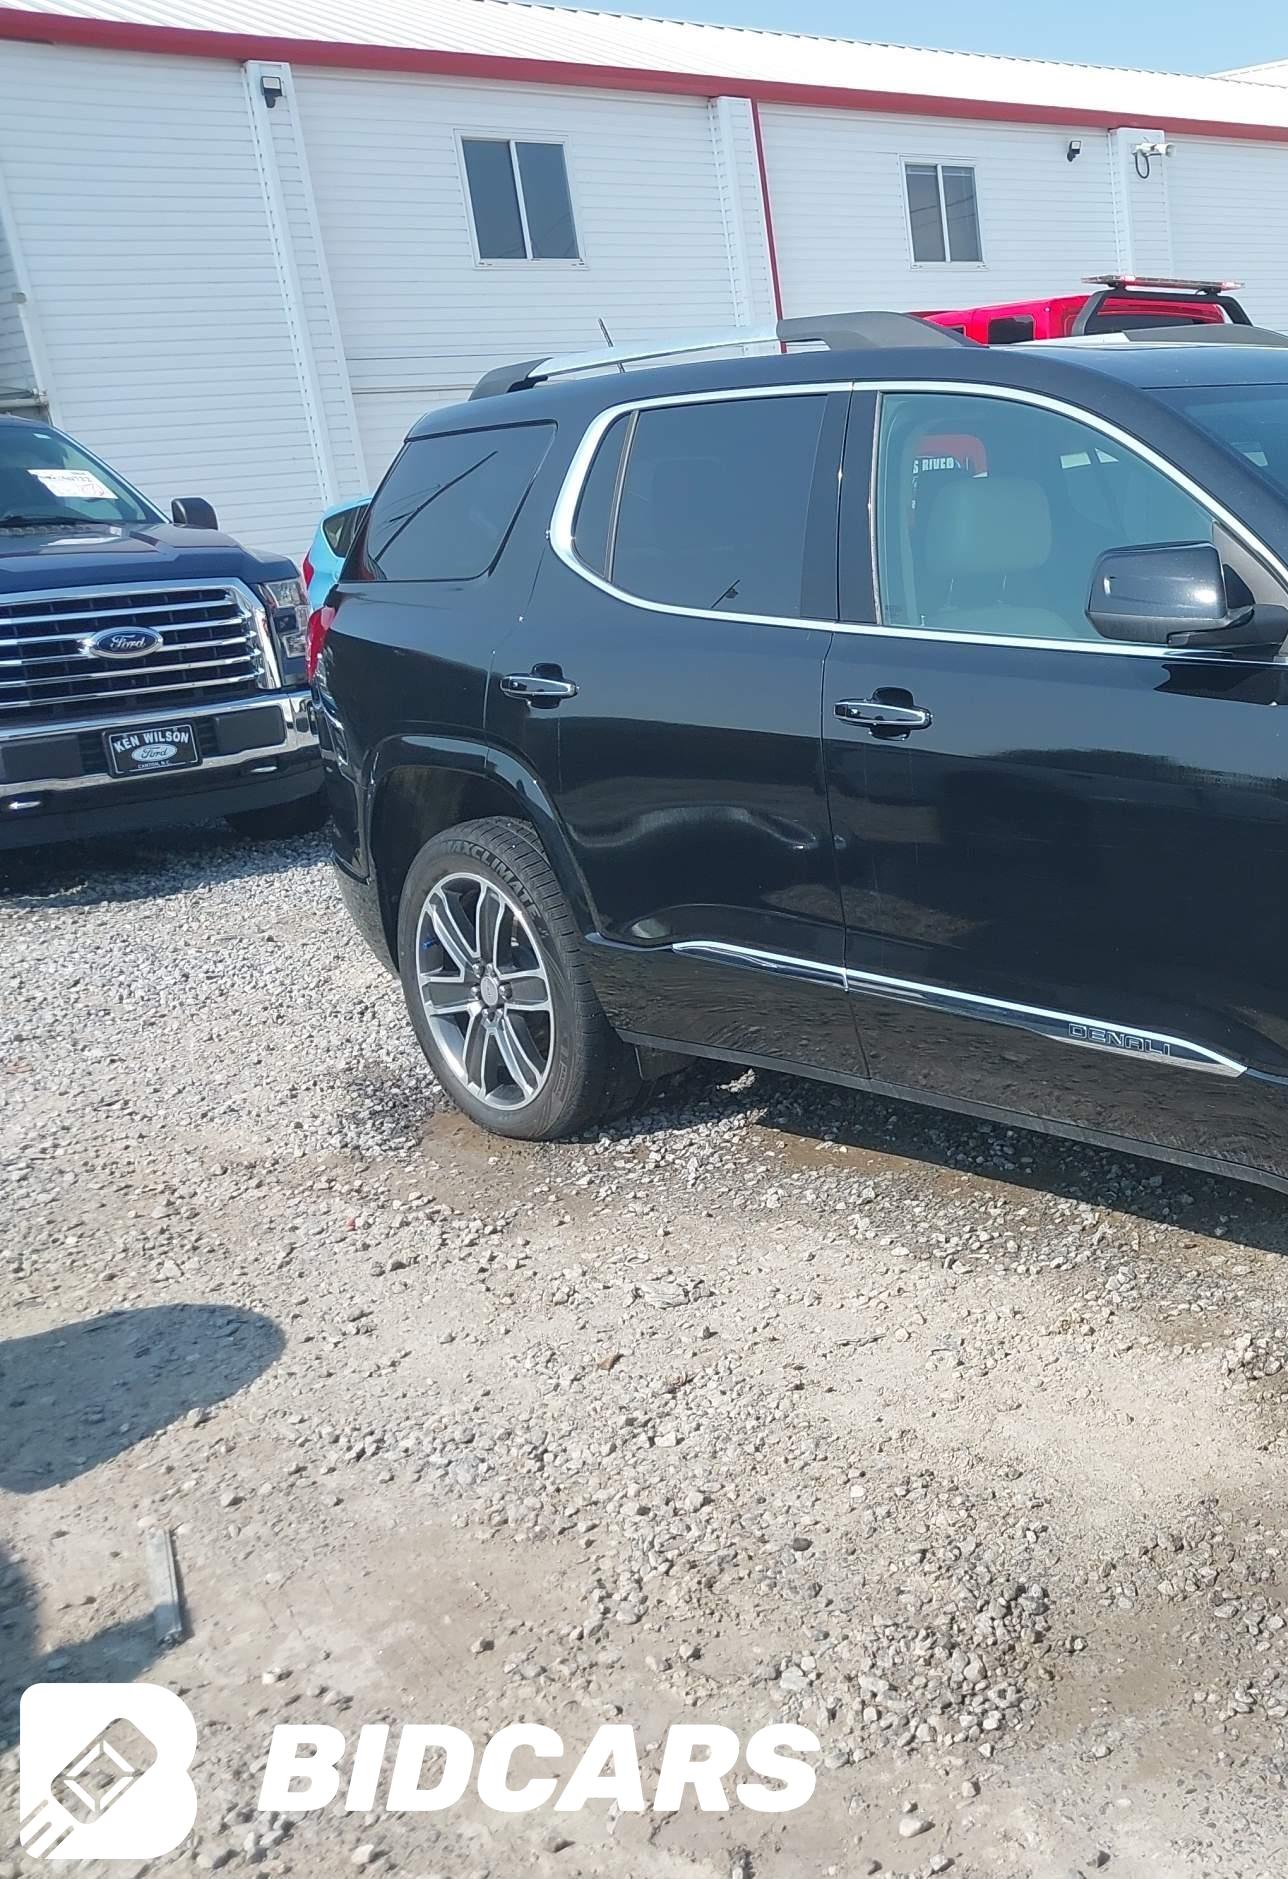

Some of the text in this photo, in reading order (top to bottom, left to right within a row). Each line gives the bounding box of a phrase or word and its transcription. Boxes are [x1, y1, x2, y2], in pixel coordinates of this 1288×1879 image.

[110, 634, 146, 649] Ford
[114, 730, 190, 753] KEN WILSON
[140, 746, 168, 759] Ford
[1068, 1023, 1171, 1057] DENALI
